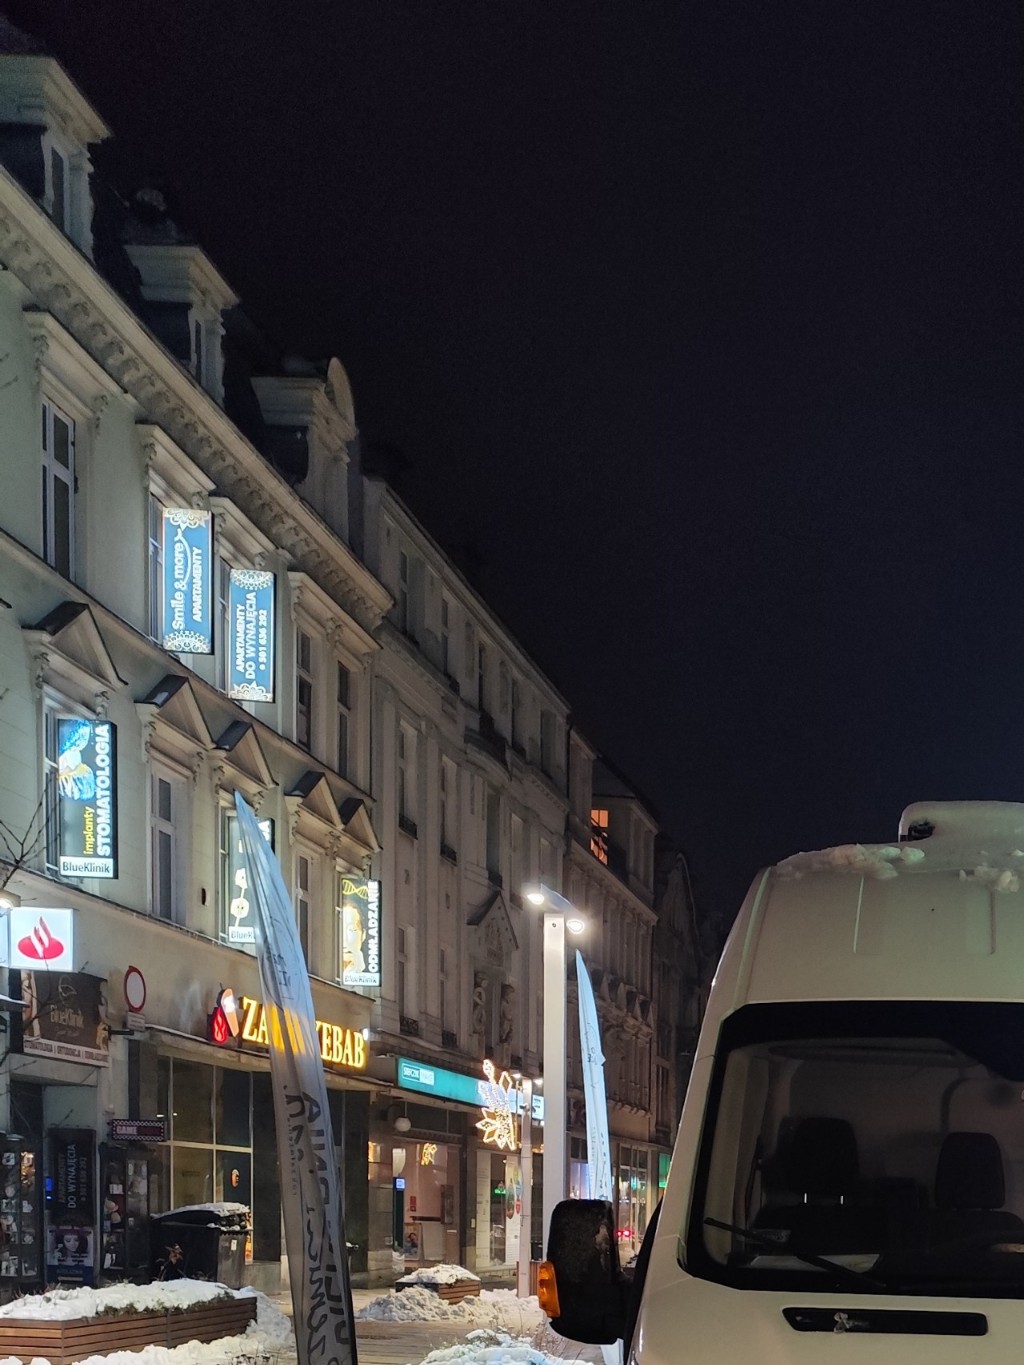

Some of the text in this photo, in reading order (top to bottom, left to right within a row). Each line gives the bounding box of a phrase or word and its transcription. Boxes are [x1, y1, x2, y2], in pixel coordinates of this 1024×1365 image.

[172, 543, 188, 630] Smile & more
[193, 547, 202, 622] APARTAMENTY
[236, 604, 245, 672] APARTAMENTY
[246, 592, 257, 679] DO WYNAJĘCIA
[259, 648, 267, 663] 501
[96, 724, 110, 856] STOMATOLOGIA
[83, 807, 95, 855] implanty
[62, 861, 110, 873] BlueKlinik
[367, 881, 379, 973] ODMŁADZANIE
[116, 1126, 137, 1135] GAME
[67, 1144, 78, 1208] DO WYNAJĘCIA
